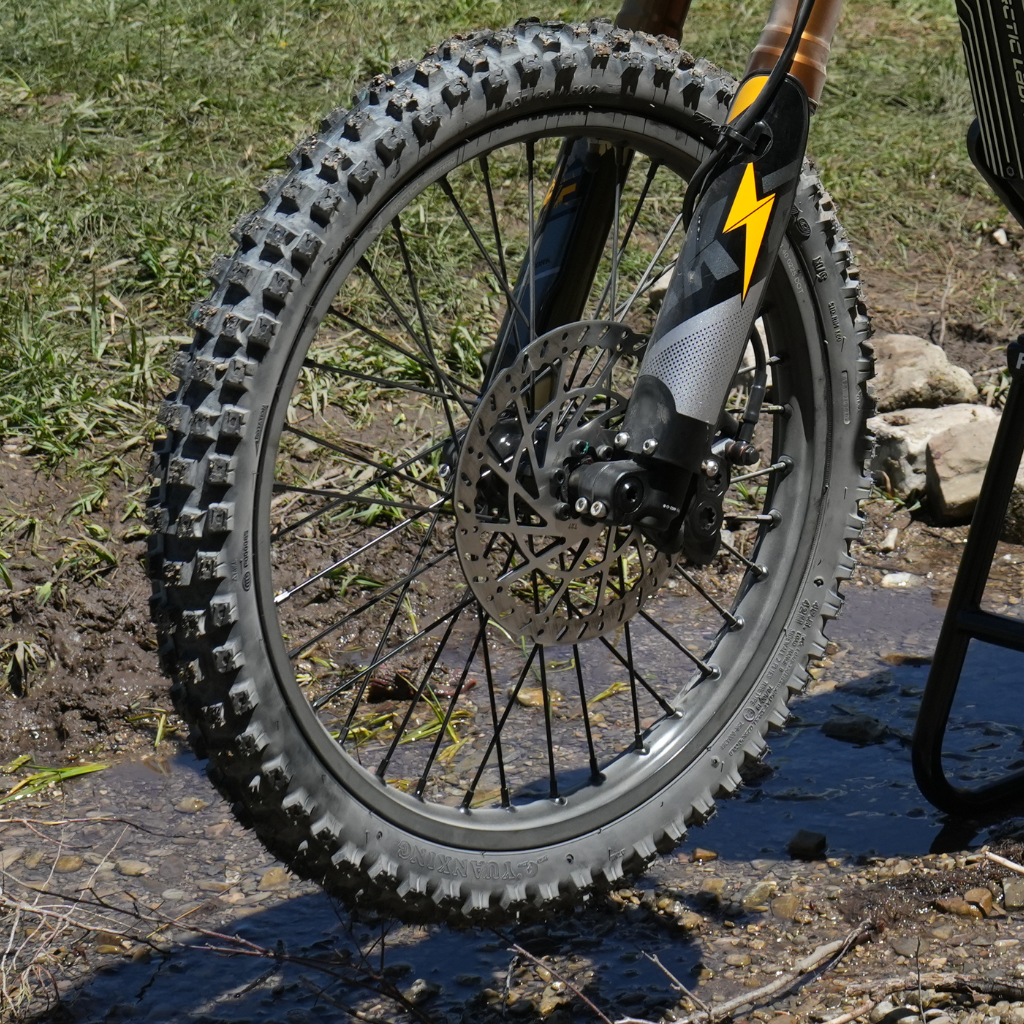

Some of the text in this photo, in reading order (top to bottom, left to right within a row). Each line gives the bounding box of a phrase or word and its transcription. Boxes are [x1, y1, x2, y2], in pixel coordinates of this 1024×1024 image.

[787, 259, 797, 277] 0225
[794, 277, 804, 294] DOT
[398, 841, 516, 879] YUANXING
